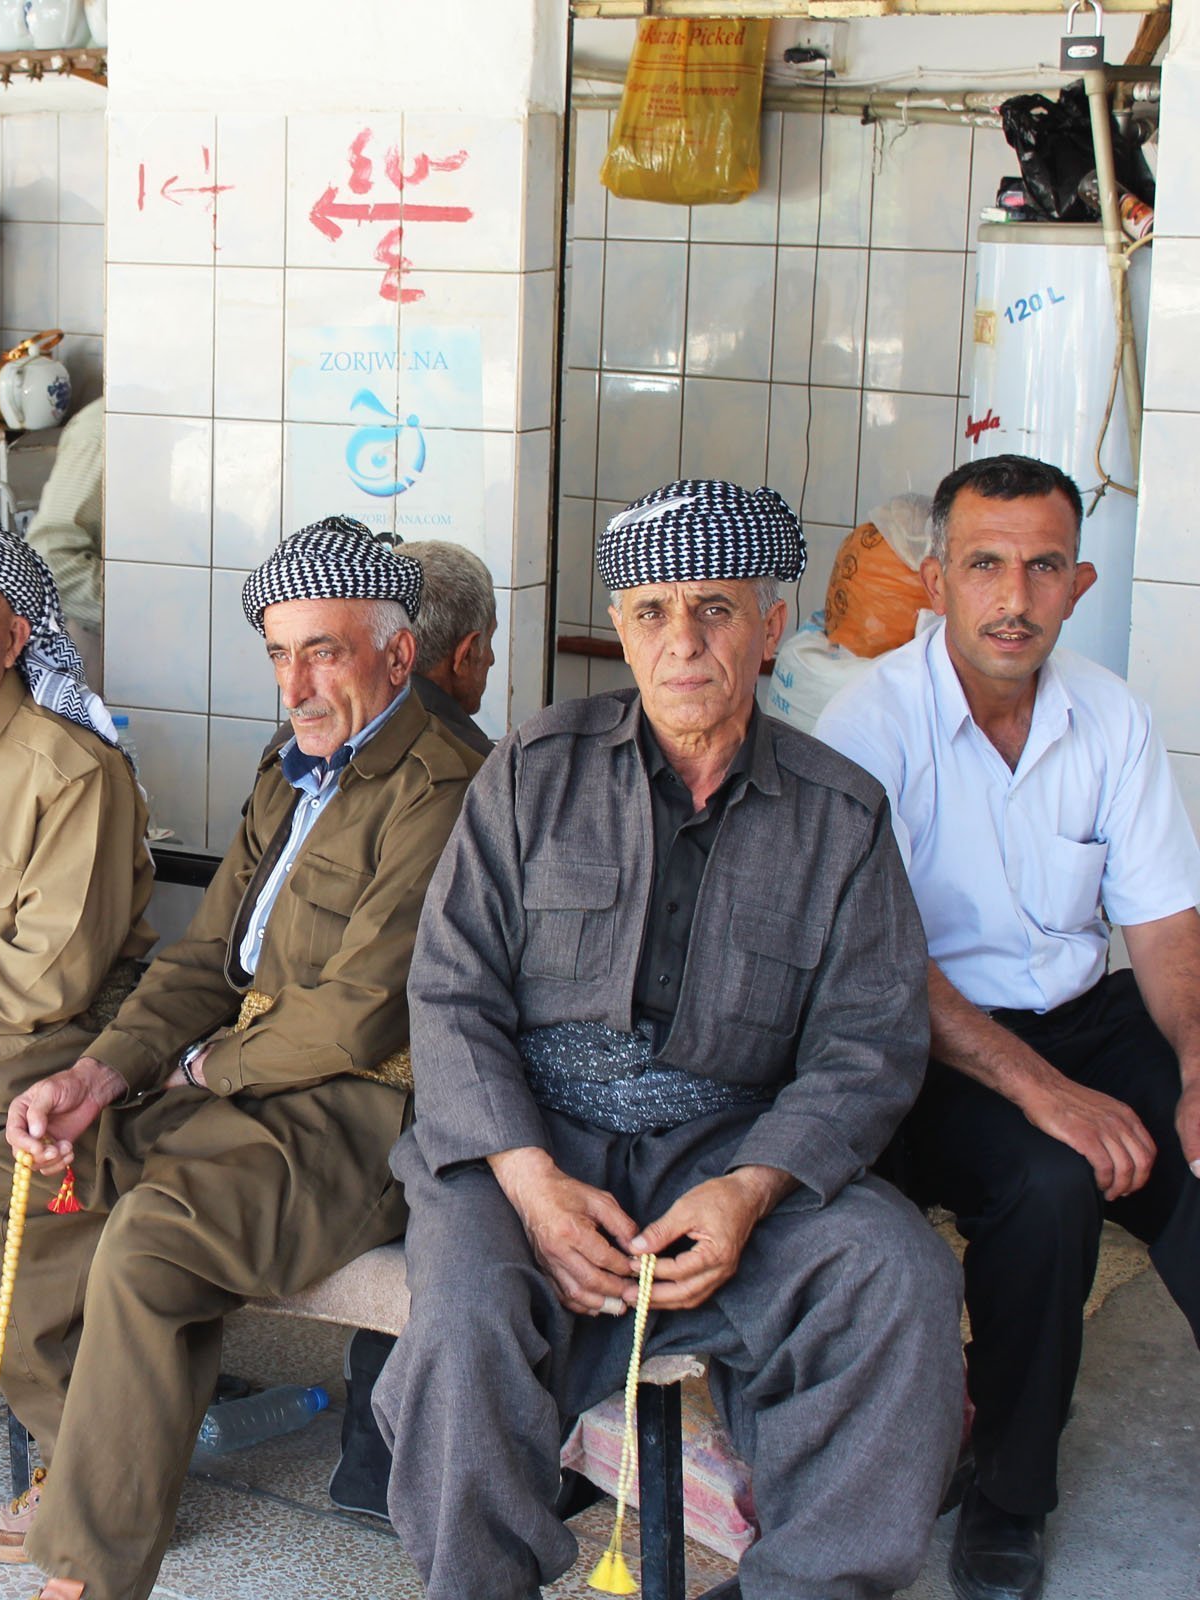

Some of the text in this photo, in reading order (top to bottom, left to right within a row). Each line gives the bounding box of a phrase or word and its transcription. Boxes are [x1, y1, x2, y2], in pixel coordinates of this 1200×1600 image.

[689, 25, 746, 46] Picked
[1004, 287, 1065, 324] 120 L
[320, 351, 449, 374] ZORJWNA
